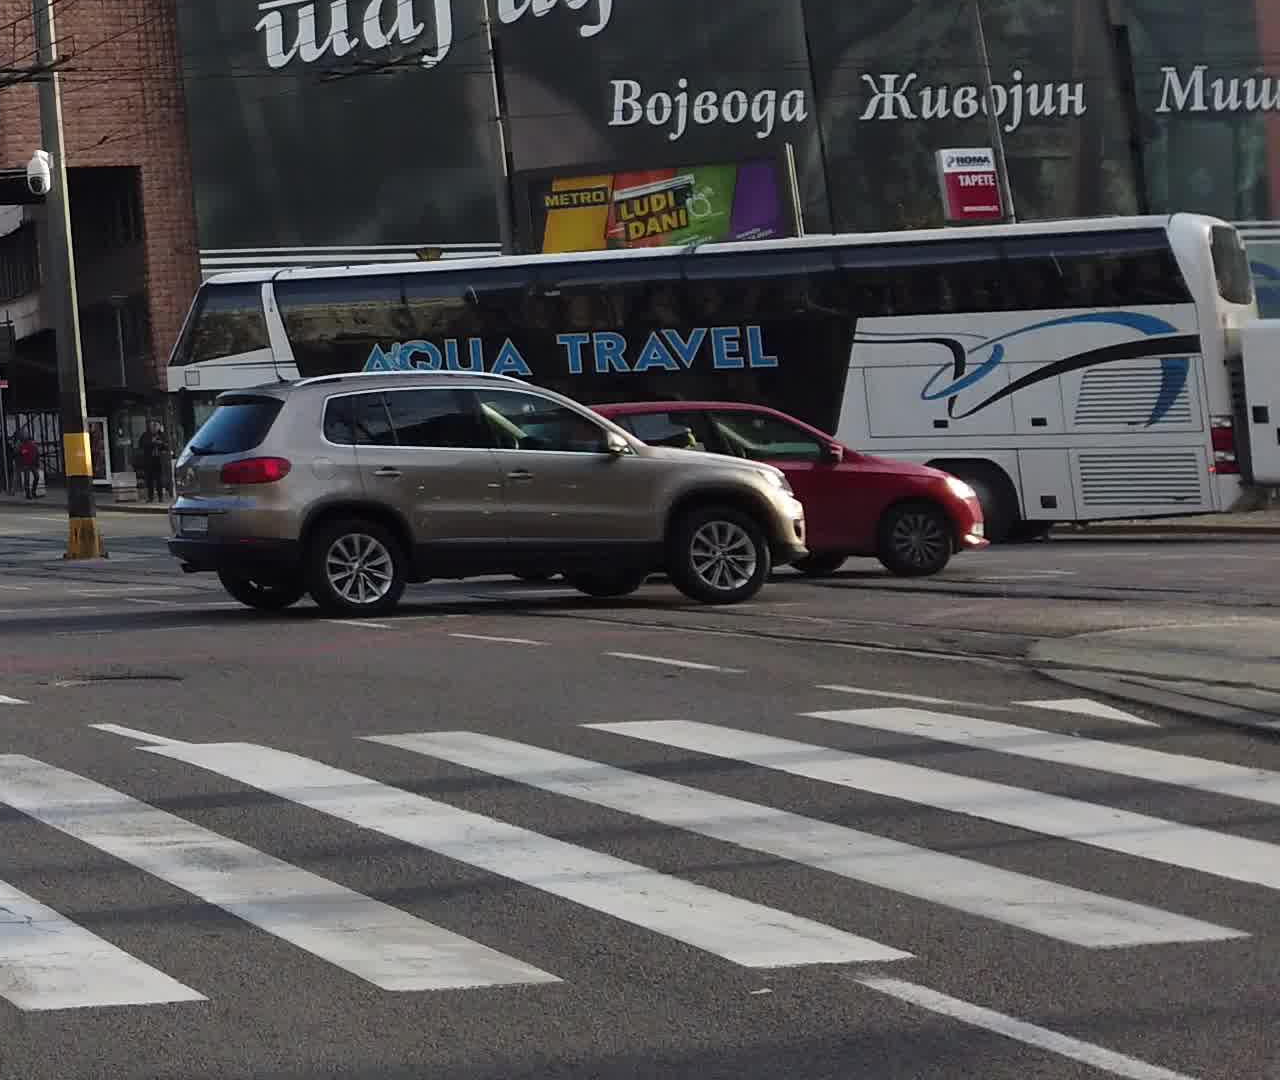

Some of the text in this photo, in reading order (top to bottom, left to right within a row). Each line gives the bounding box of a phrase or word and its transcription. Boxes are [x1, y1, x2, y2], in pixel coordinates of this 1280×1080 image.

[609, 78, 808, 139] Војвода
[861, 70, 1088, 133] Живојин
[958, 174, 996, 187] TAPETE
[543, 191, 605, 208] METRO
[619, 191, 676, 221] LUDI
[627, 208, 688, 239] DANI
[363, 325, 778, 376] AQUA TRAVEL
